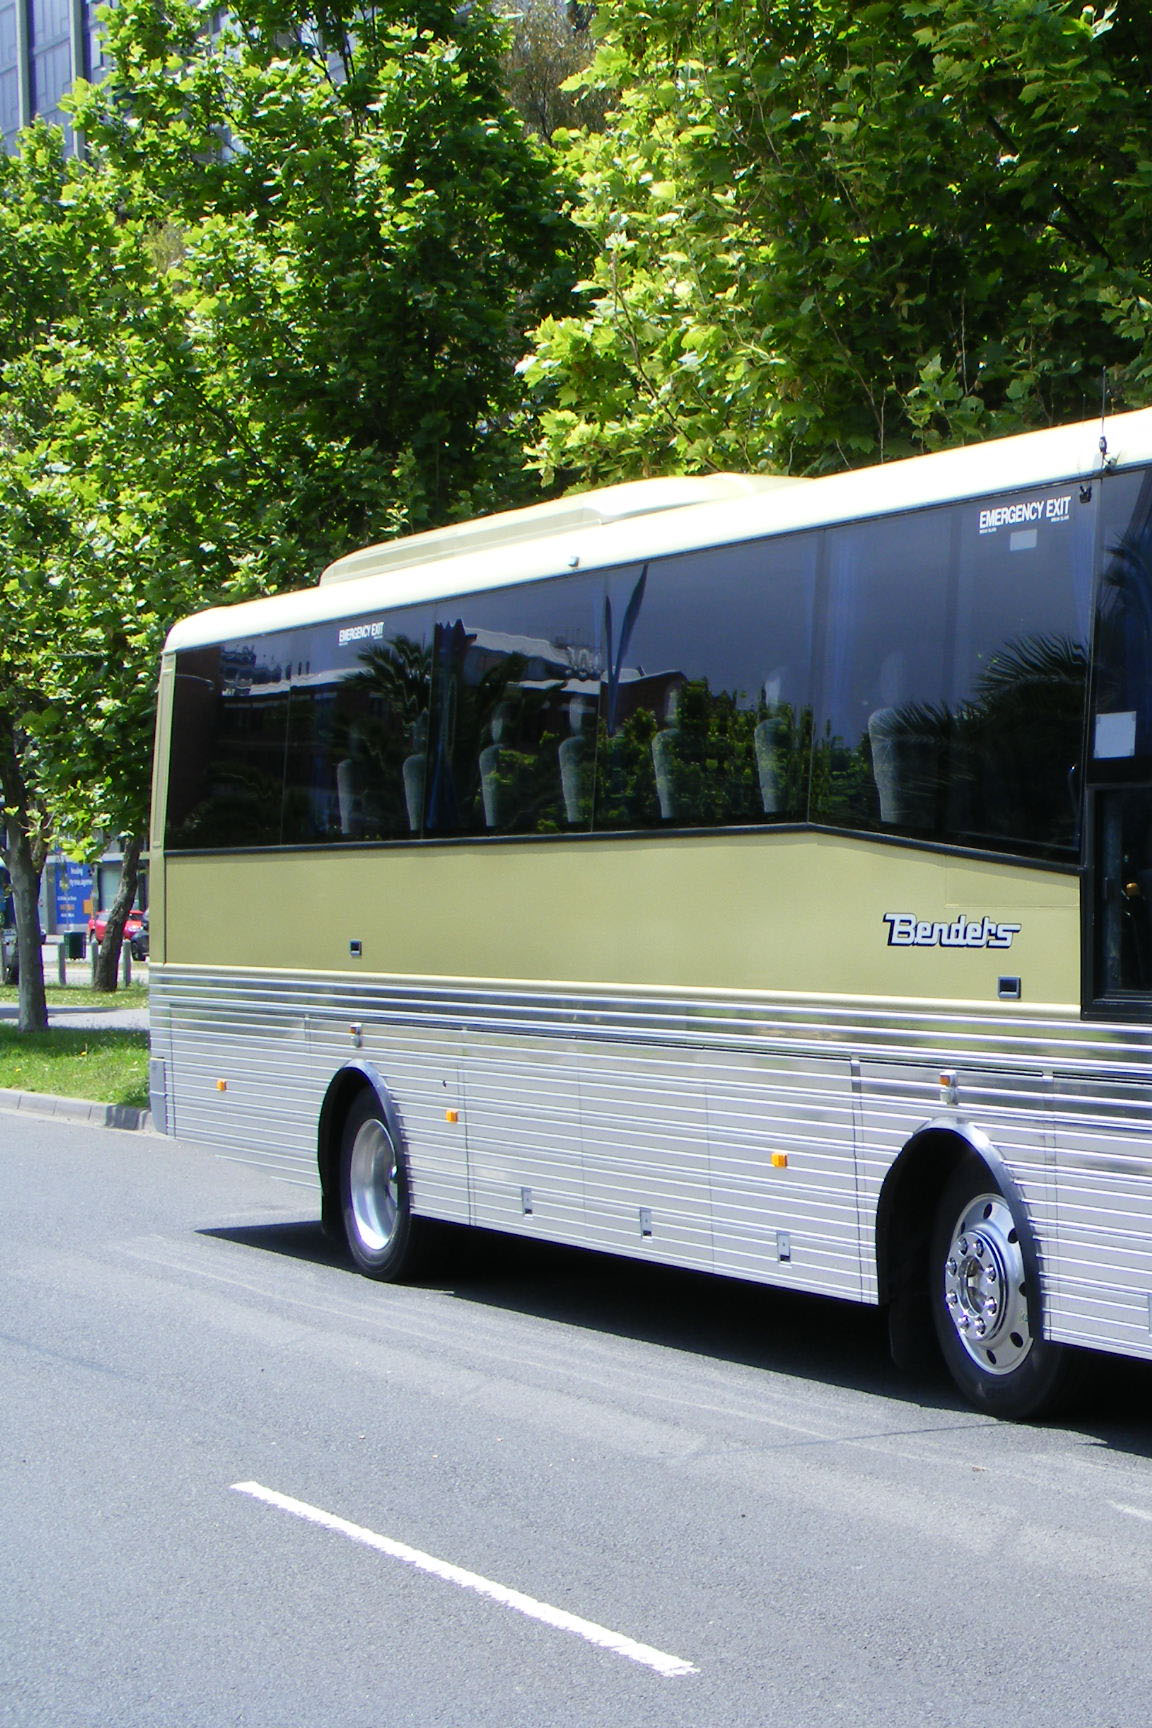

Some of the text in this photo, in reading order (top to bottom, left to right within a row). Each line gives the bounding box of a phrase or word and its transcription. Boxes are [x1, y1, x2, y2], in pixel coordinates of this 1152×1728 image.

[979, 496, 1072, 529] EMERGENCY EXIT
[338, 621, 385, 643] EMERGENCY EXIT
[883, 912, 1022, 949] Benders
